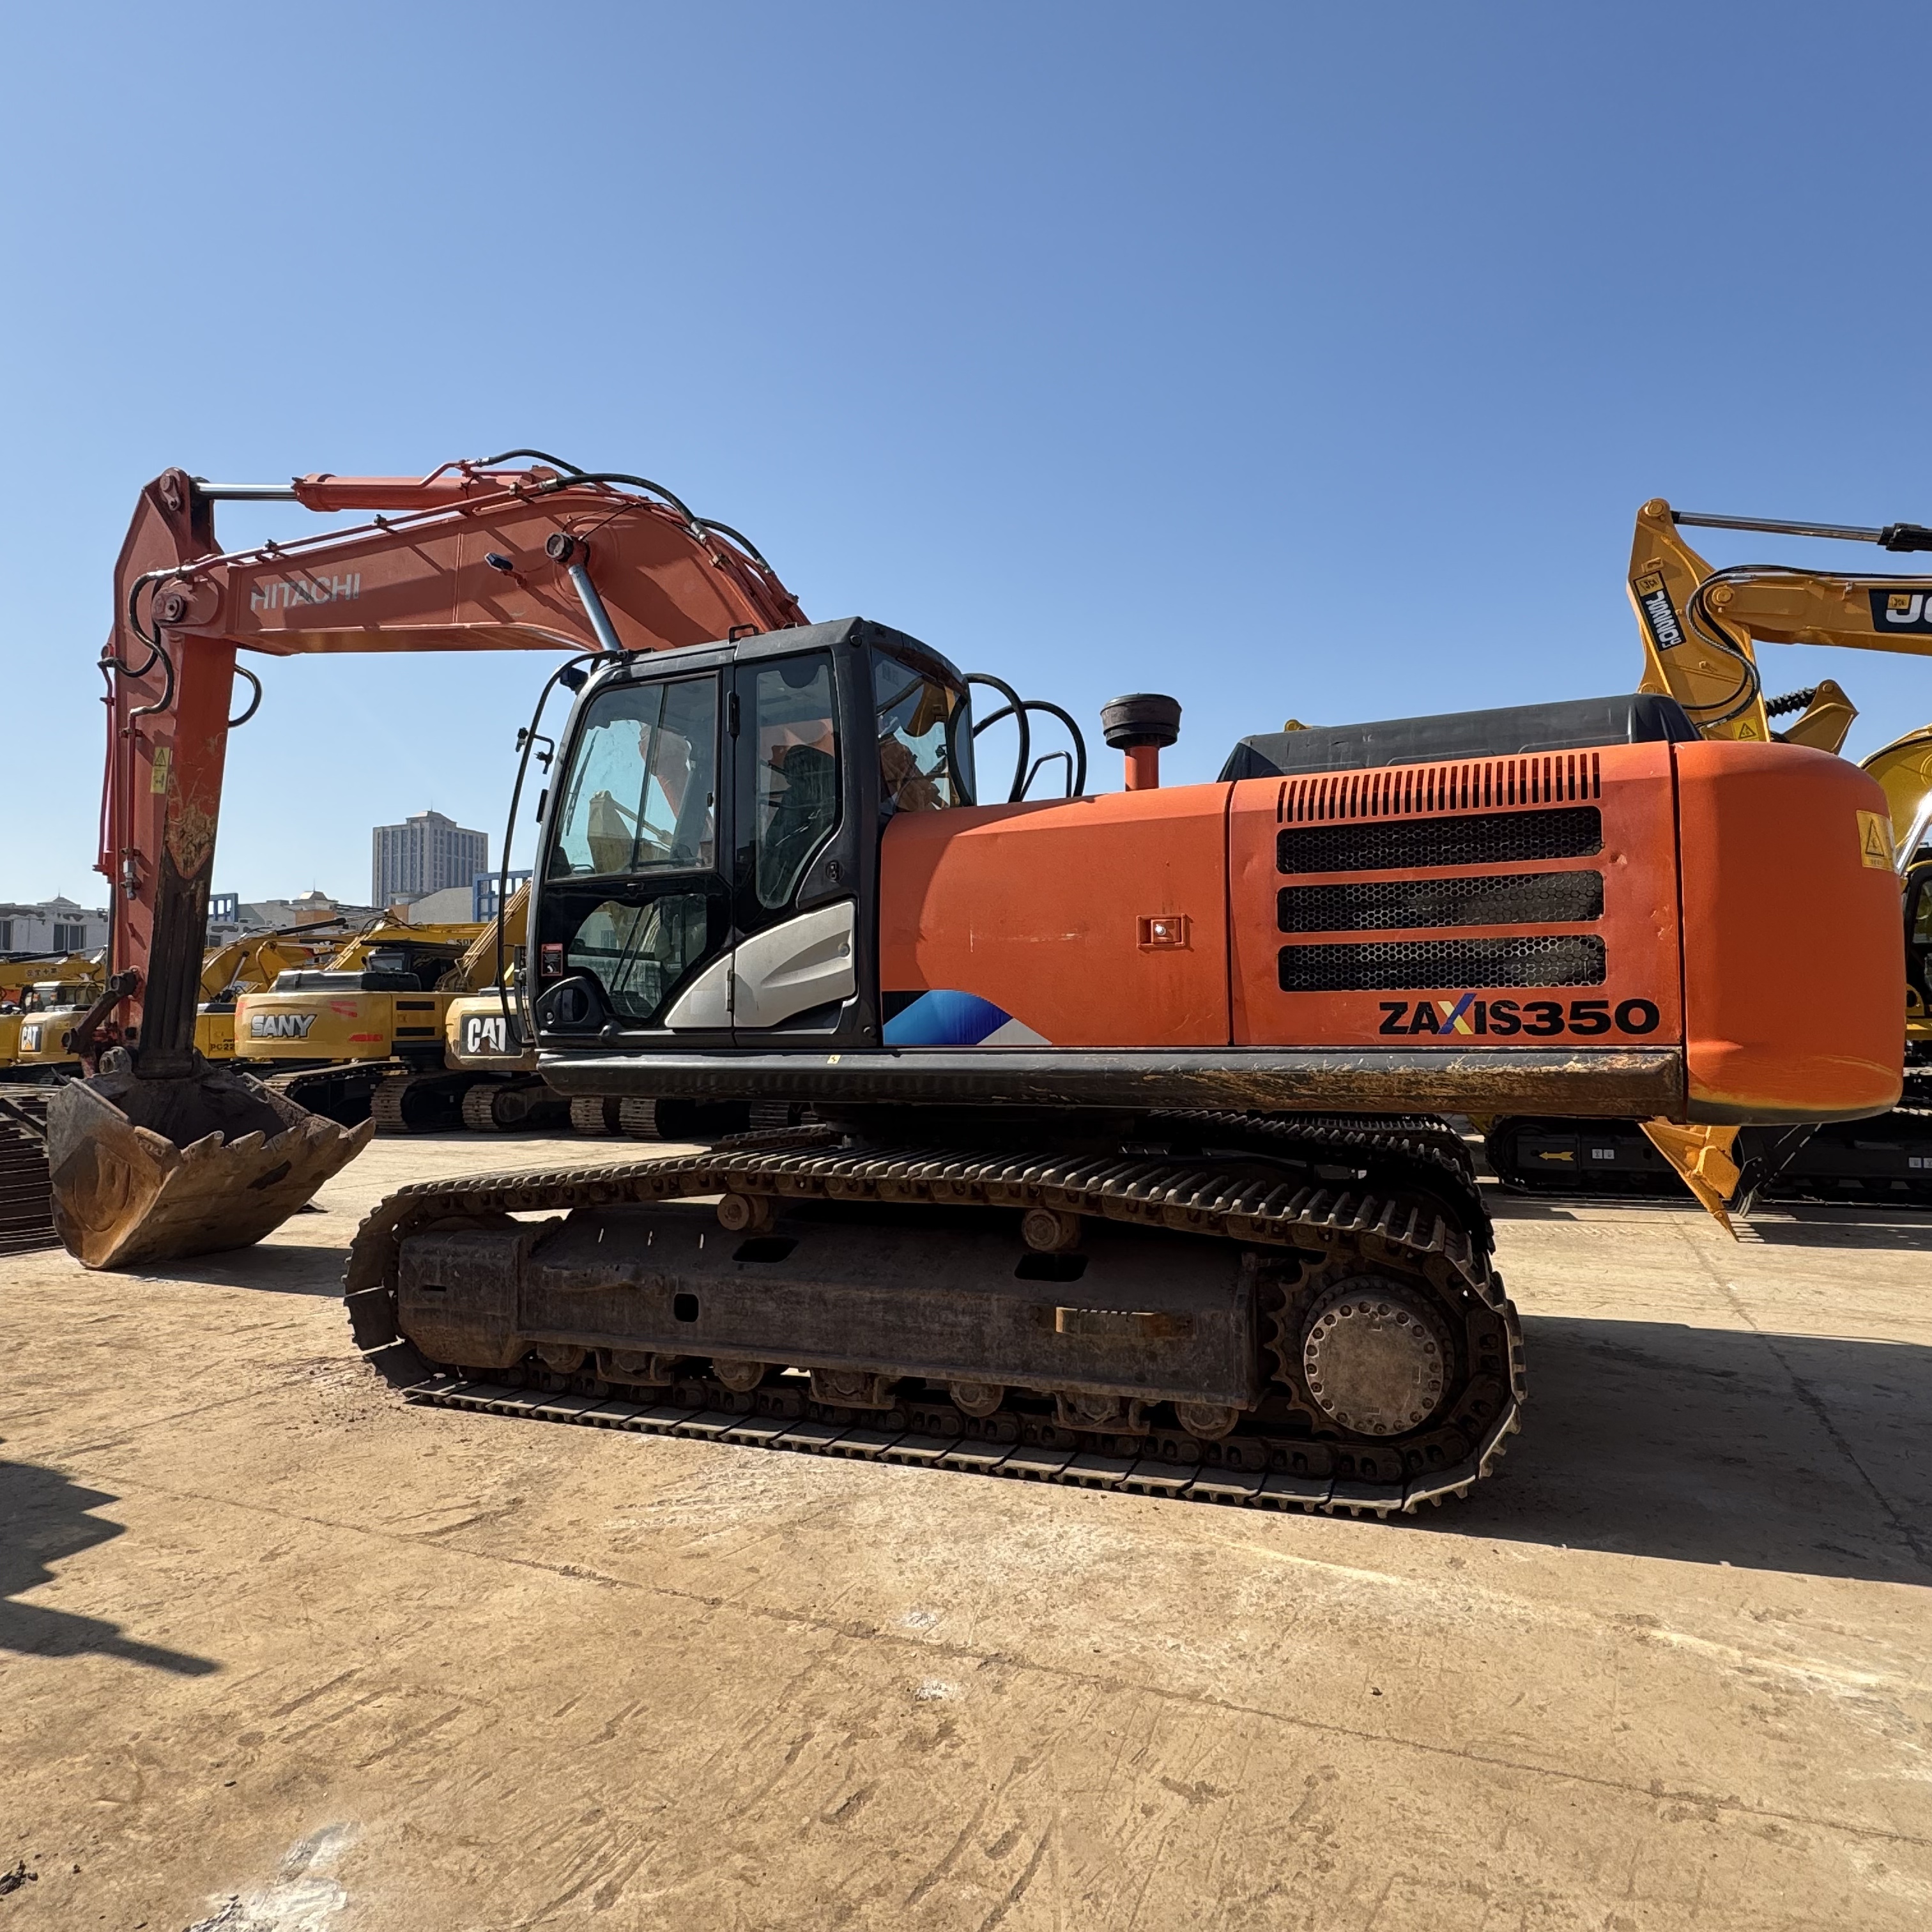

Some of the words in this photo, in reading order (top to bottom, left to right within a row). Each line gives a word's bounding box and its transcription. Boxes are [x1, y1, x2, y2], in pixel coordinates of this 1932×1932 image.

[250, 572, 360, 610] HITACHI
[1885, 595, 1932, 624] J
[251, 1014, 317, 1038] SANY
[1379, 993, 1660, 1036] ZAXIS350
[22, 1026, 39, 1050] CAT
[468, 1018, 506, 1053] CAT
